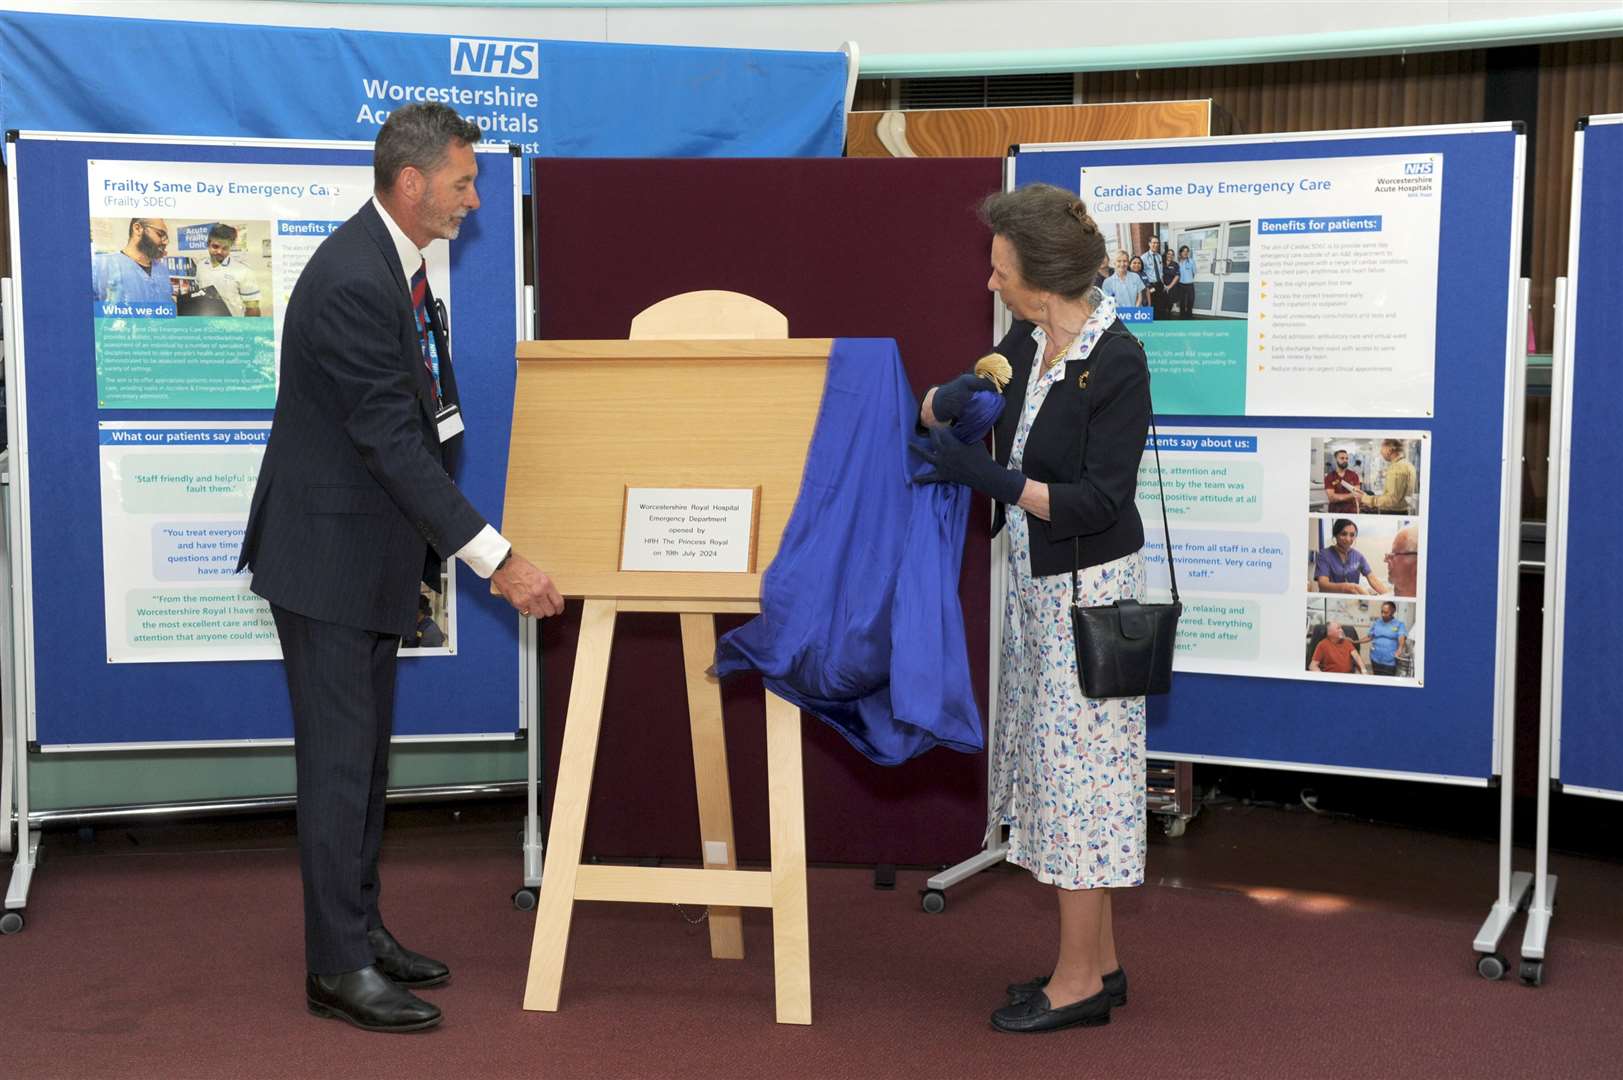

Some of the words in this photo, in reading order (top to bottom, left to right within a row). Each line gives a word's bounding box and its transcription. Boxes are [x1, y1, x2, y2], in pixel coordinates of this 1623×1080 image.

[454, 42, 534, 75] NHS
[363, 79, 538, 108] Worcestershire
[1406, 164, 1432, 174] NHS
[1377, 177, 1432, 185] Worcestershire
[104, 180, 148, 194] Frailty
[153, 181, 192, 193] Same
[197, 182, 223, 196] Day
[229, 183, 304, 197] Emergency
[1094, 184, 1142, 198] Cardiac
[1146, 182, 1183, 197] Same
[1187, 182, 1214, 198] Day
[1218, 180, 1295, 196] Emergency
[1299, 178, 1332, 192] Care
[104, 196, 140, 208] (Frailty
[144, 197, 176, 208] SDEC)
[1093, 201, 1134, 213] (Cardiac
[1137, 200, 1169, 212] SDEC)
[281, 223, 325, 233] Benefits
[1262, 221, 1306, 231] Benefits
[1309, 220, 1325, 230] for
[1328, 219, 1377, 232] patients:
[102, 305, 132, 316] What
[135, 307, 152, 316] we
[155, 305, 173, 316] do:
[1134, 310, 1150, 320] do:
[112, 432, 142, 440] What
[166, 432, 210, 442] patients
[213, 433, 230, 442] say
[234, 431, 265, 440] about
[1180, 439, 1198, 449] say
[1200, 438, 1232, 448] about
[1234, 440, 1250, 448] us:
[1170, 468, 1209, 476] attention
[1210, 468, 1227, 476] and
[160, 474, 193, 484] friendly
[215, 474, 245, 484] helpful
[186, 485, 206, 493] fault
[1176, 480, 1186, 490] by
[1188, 481, 1202, 489] the
[1166, 494, 1198, 503] positive
[1200, 494, 1234, 503] attitude
[639, 503, 688, 511] Worcestershire
[690, 504, 710, 512] Royal
[682, 550, 696, 558] July
[1185, 544, 1205, 552] from
[1219, 545, 1238, 553] staff
[1240, 546, 1250, 554] in
[1258, 546, 1284, 556] clean,
[168, 554, 209, 563] questions
[1172, 557, 1222, 566] nvironment.
[1224, 558, 1244, 568] Very
[1246, 560, 1272, 569] caring
[183, 595, 197, 603] the
[137, 608, 201, 616] Worcestershire
[203, 607, 226, 616] Royal
[1192, 604, 1226, 614] relaxing
[1228, 606, 1245, 615] and
[1207, 618, 1253, 630] Everything
[134, 634, 174, 642] attention
[196, 634, 227, 642] anyone
[1176, 630, 1198, 638] efore
[1200, 631, 1216, 640] and
[1217, 632, 1239, 641] after
